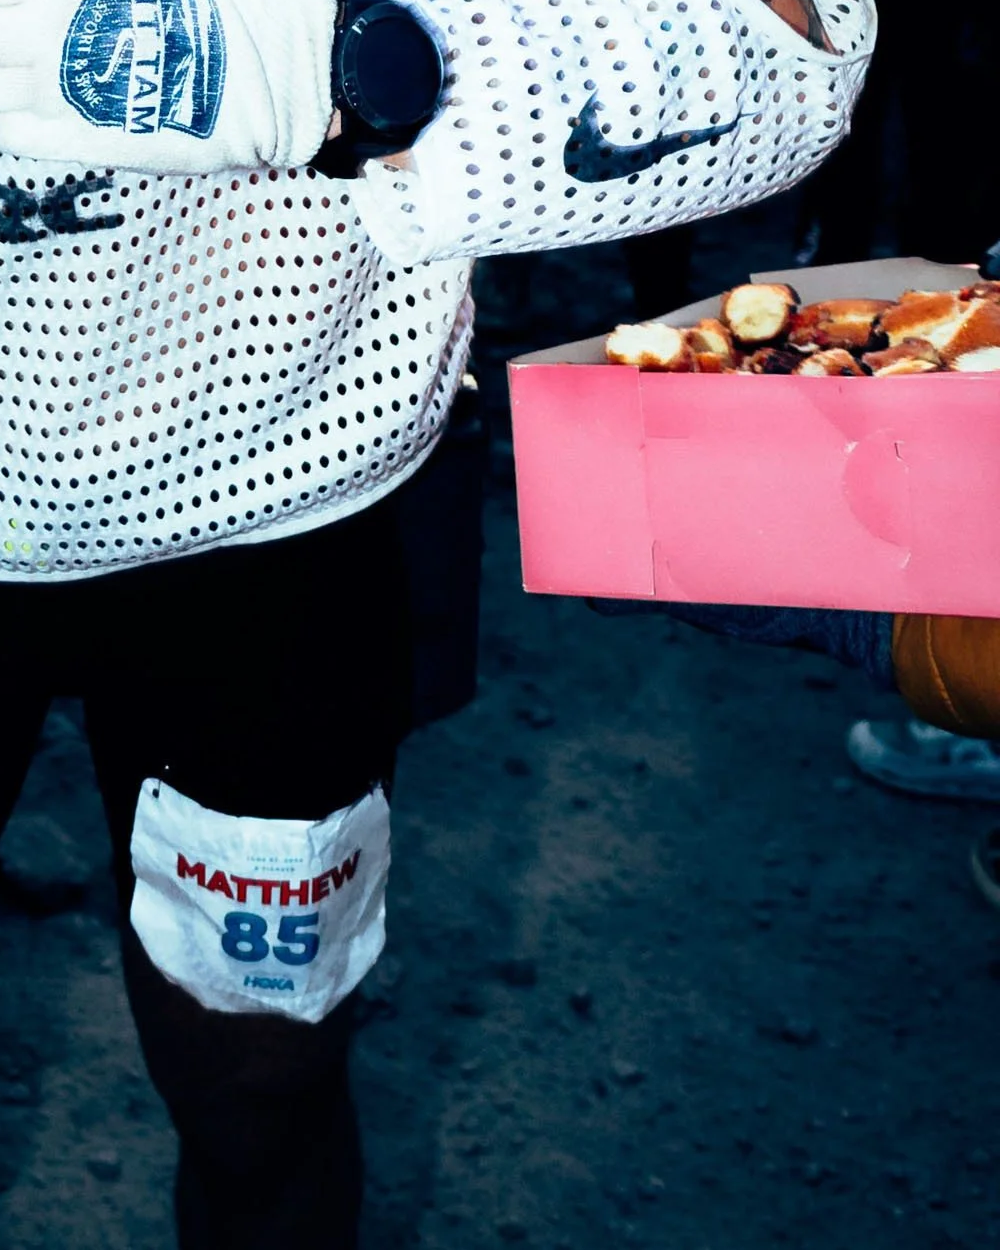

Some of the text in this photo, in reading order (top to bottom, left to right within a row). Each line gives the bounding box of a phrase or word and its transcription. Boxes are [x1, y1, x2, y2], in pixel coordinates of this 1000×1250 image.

[77, 0, 109, 52] SPORT
[74, 72, 104, 108] SPINE
[130, 50, 161, 134] TAM
[175, 849, 362, 906] MATTHEW
[221, 911, 320, 966] 85
[243, 975, 295, 991] HOKA
